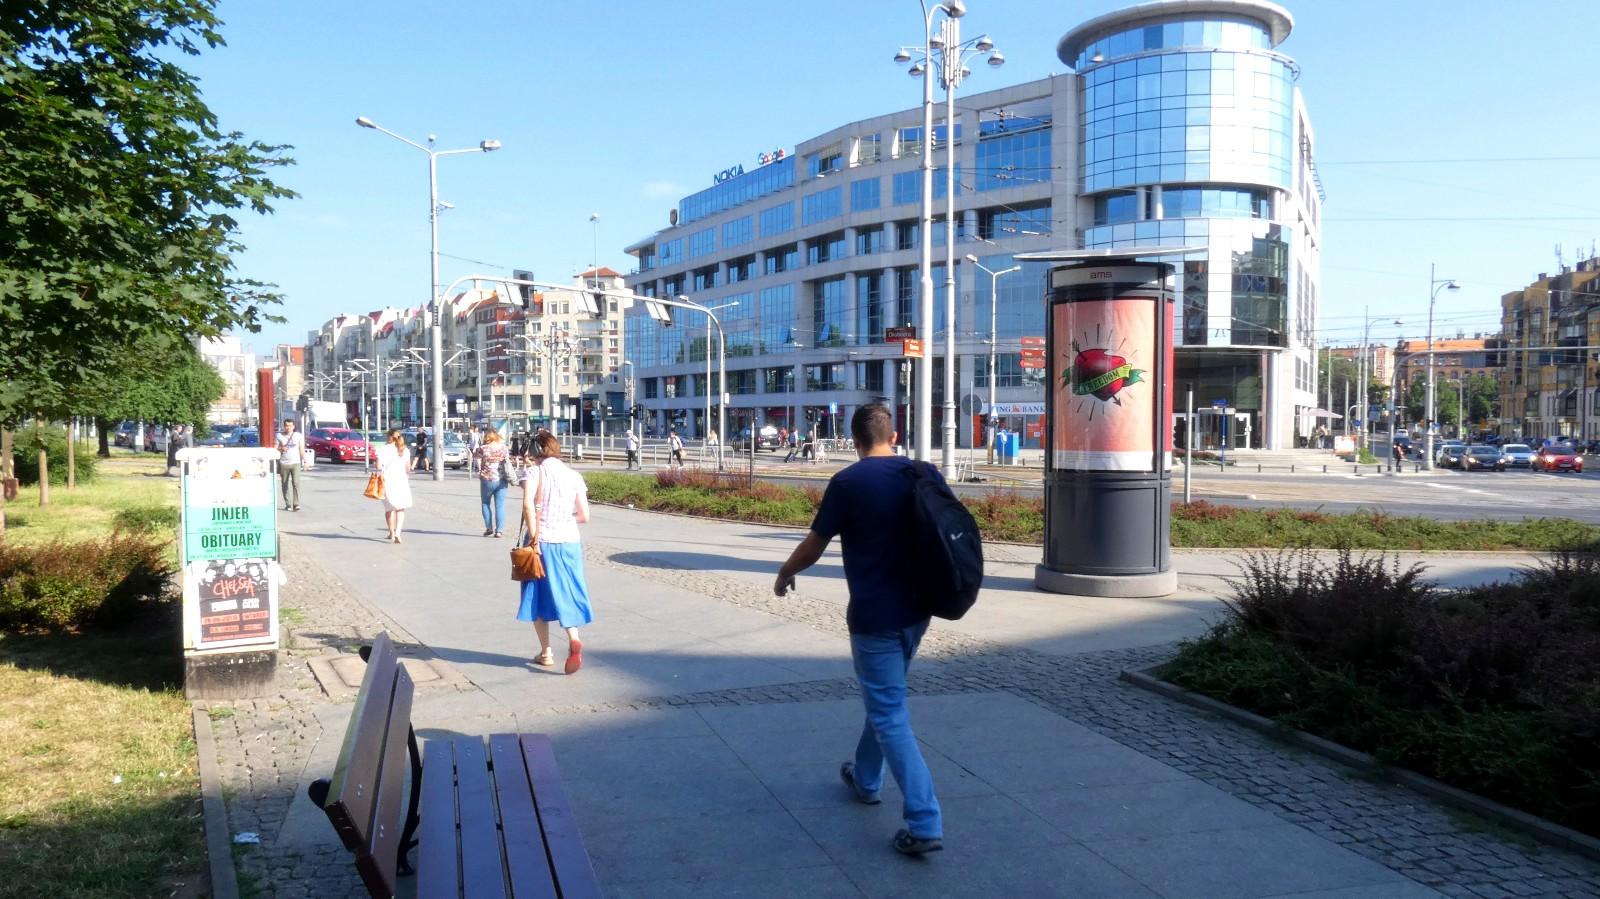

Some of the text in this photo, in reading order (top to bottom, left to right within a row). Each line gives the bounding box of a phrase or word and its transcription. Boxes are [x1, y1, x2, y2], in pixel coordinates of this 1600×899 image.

[758, 146, 785, 165] Google
[713, 163, 744, 185] NOKIA
[1090, 271, 1112, 279] ams
[1082, 369, 1119, 391] FREEDOM
[212, 506, 249, 521] JINJER
[201, 533, 261, 549] OBITUARY
[213, 576, 255, 599] CHELSEA
